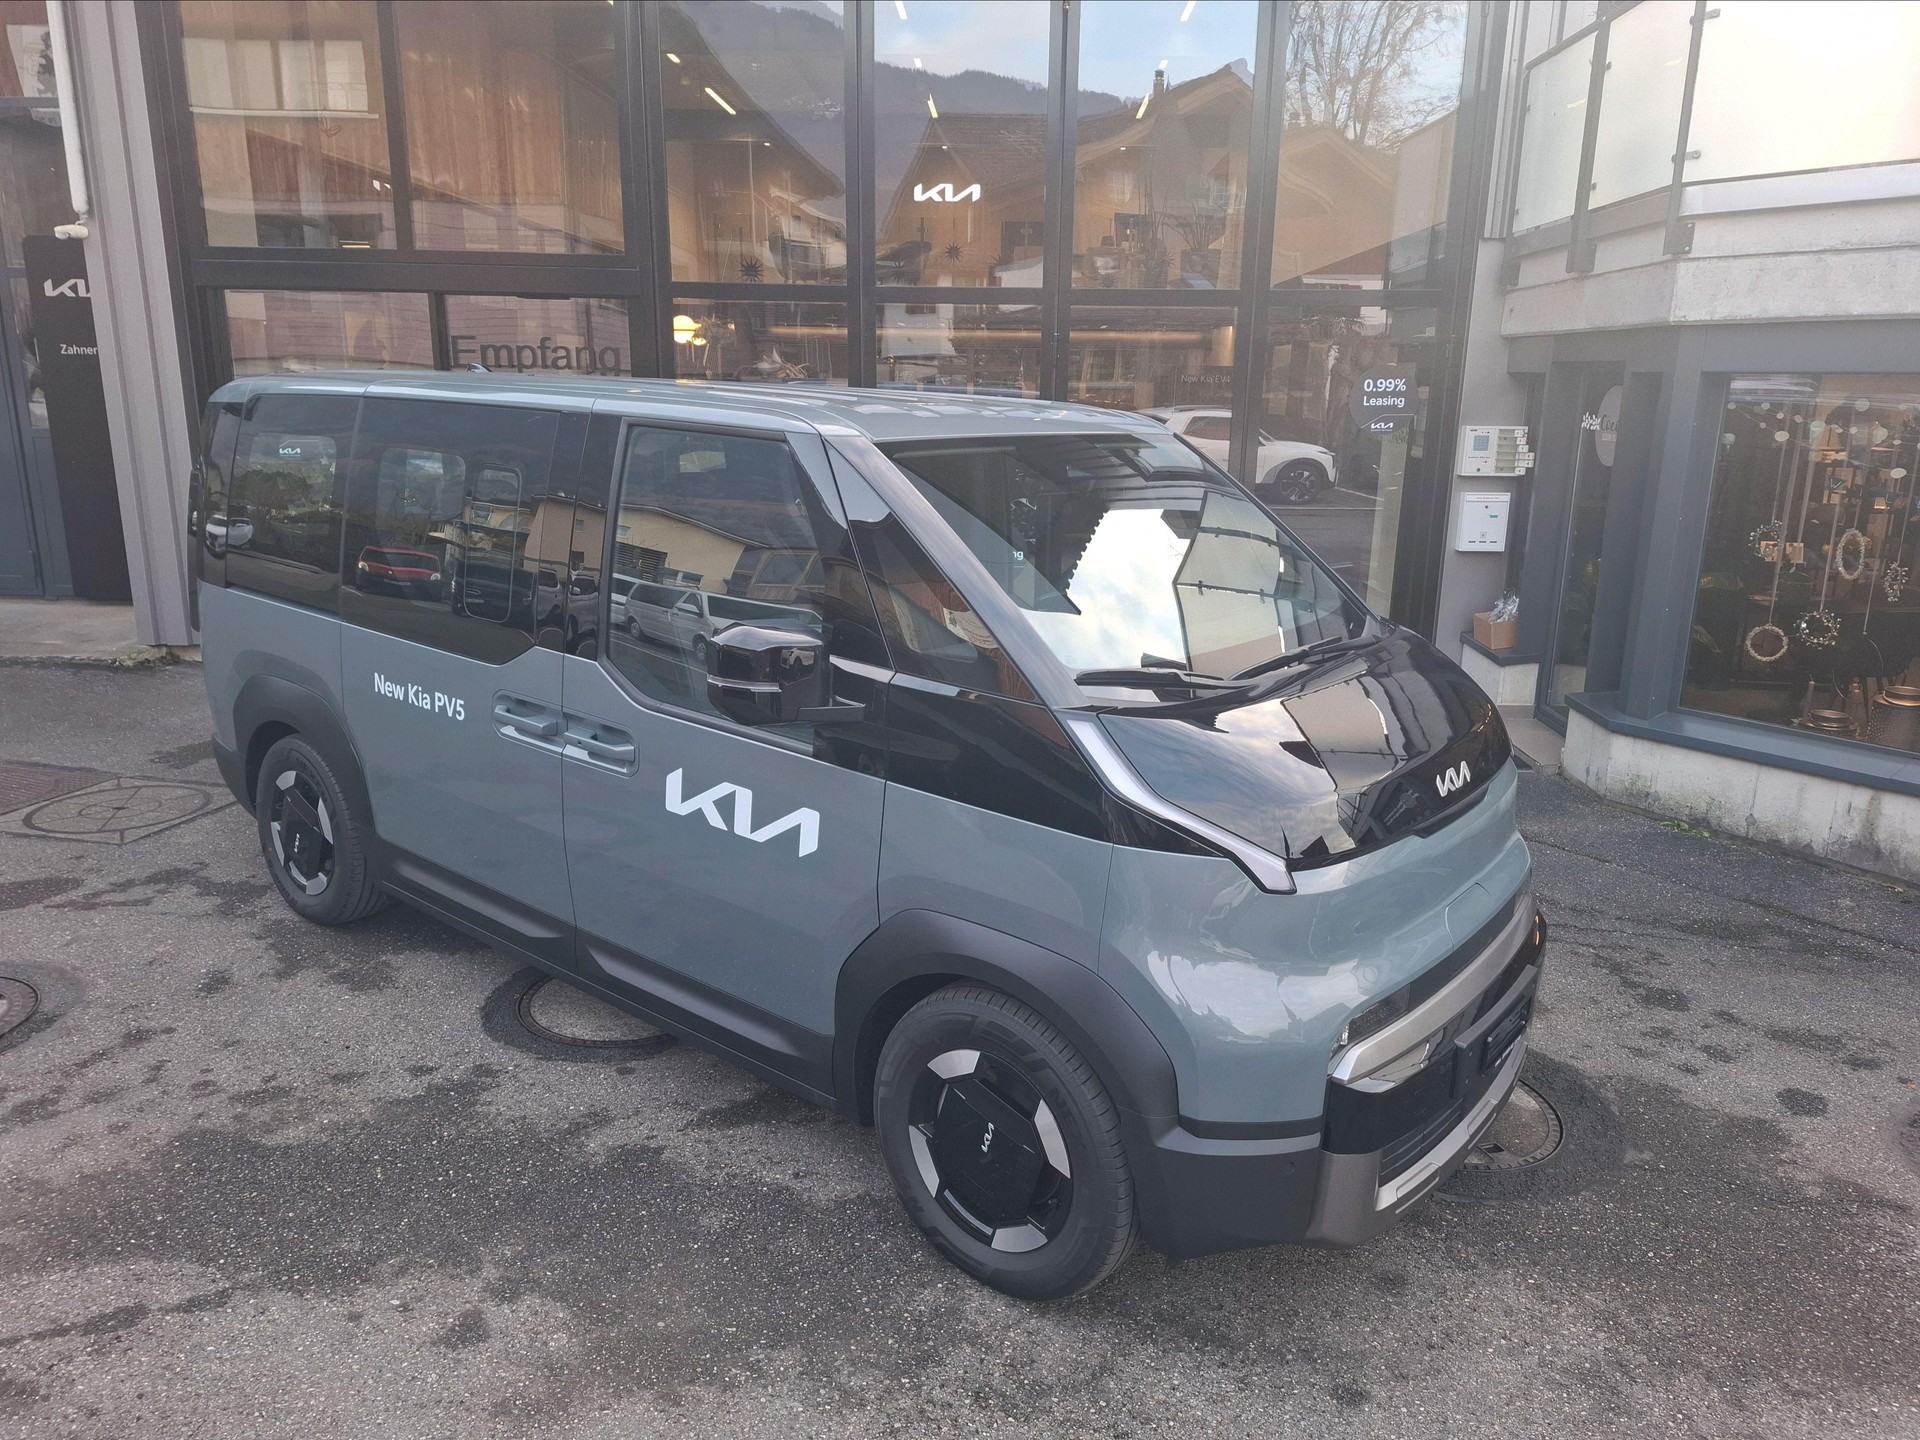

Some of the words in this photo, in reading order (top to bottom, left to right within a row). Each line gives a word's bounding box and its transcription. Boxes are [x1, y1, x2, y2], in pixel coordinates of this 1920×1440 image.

[913, 183, 981, 202] KIA
[43, 278, 91, 298] KI
[60, 344, 98, 355] Zahner
[450, 335, 620, 376] Empfang
[1363, 378, 1406, 391] 0.99%
[1363, 396, 1405, 408] Leasing
[374, 672, 404, 701] New
[408, 683, 431, 710] Kia
[434, 691, 465, 721] PV5
[1436, 760, 1471, 797] KIA
[665, 767, 820, 858] KIA
